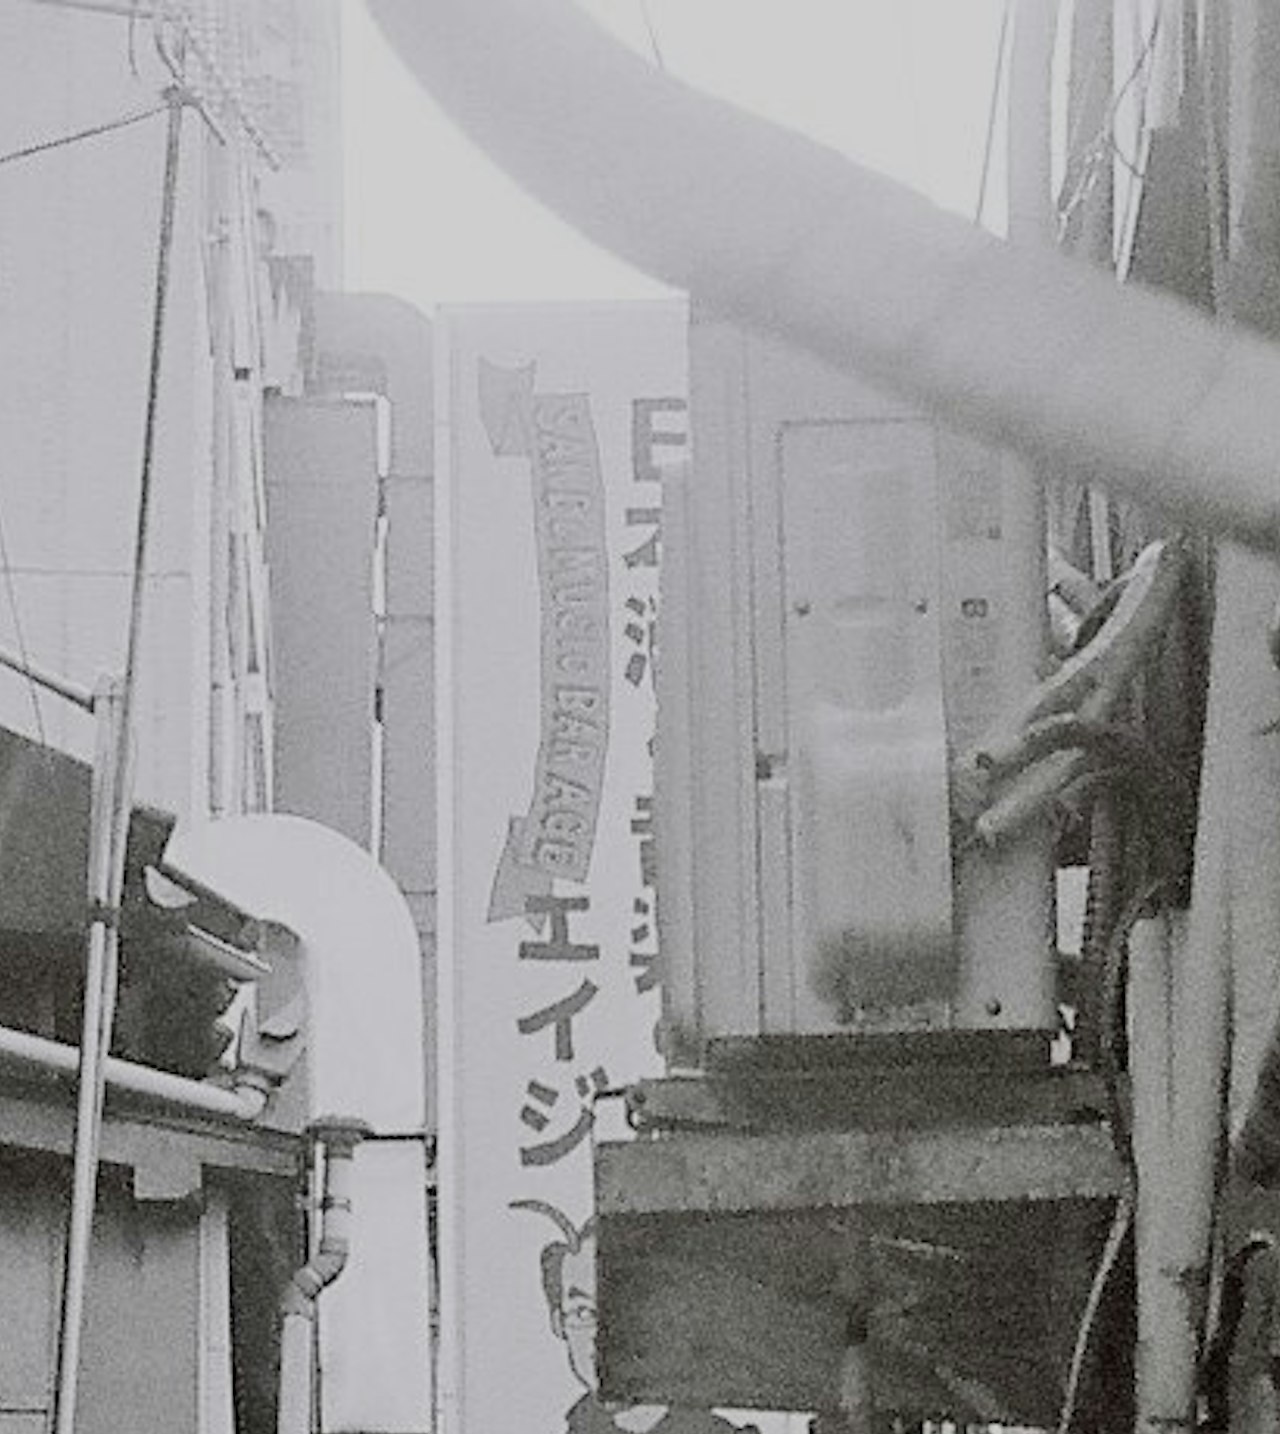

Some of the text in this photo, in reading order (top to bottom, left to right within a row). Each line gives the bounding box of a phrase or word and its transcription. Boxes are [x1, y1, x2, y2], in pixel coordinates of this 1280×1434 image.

[531, 774, 592, 870] AGE
[516, 895, 609, 1168] エイジ
